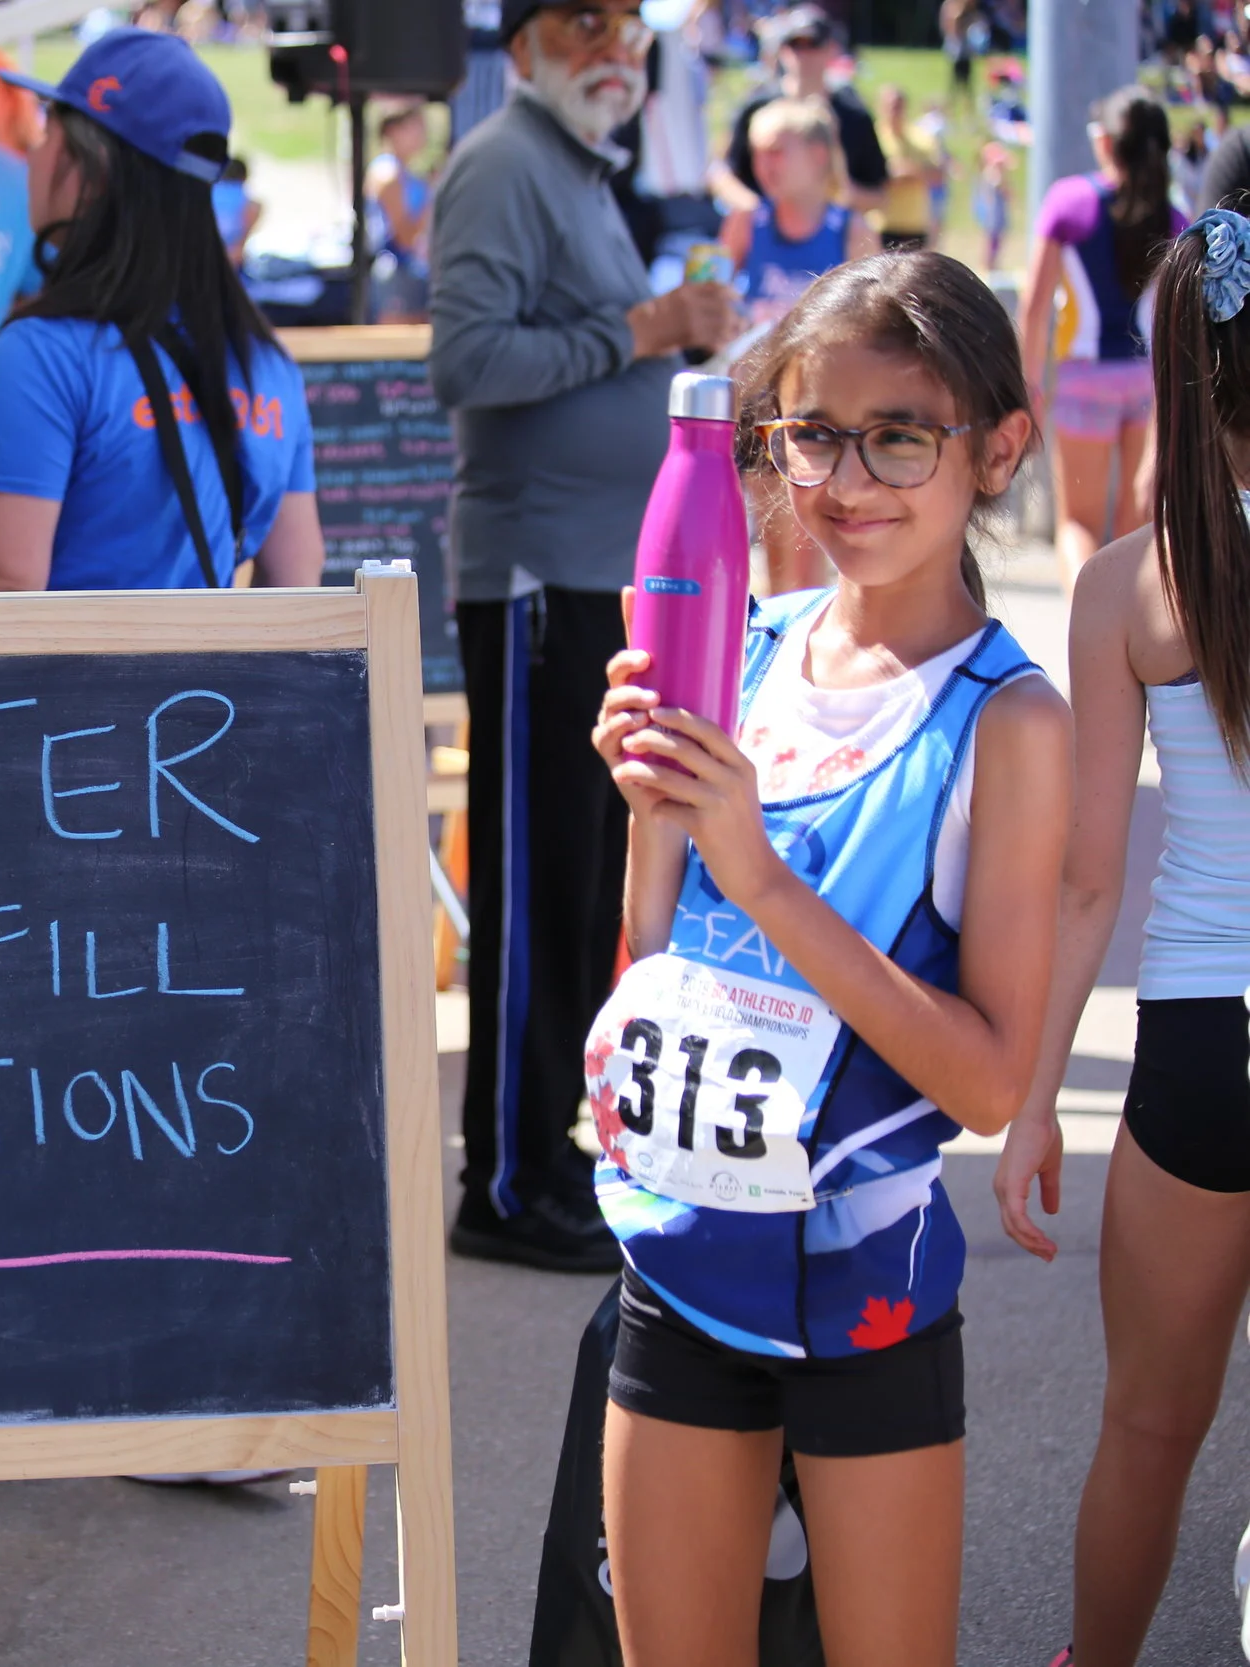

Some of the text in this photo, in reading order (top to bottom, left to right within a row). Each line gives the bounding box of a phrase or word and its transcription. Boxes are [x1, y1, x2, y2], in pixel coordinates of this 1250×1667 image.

[729, 986, 796, 1021] ATHLETICS
[797, 1005, 814, 1025] JD
[734, 1009, 811, 1041] CHAMPIONSHIPS
[618, 1018, 782, 1159] 313
